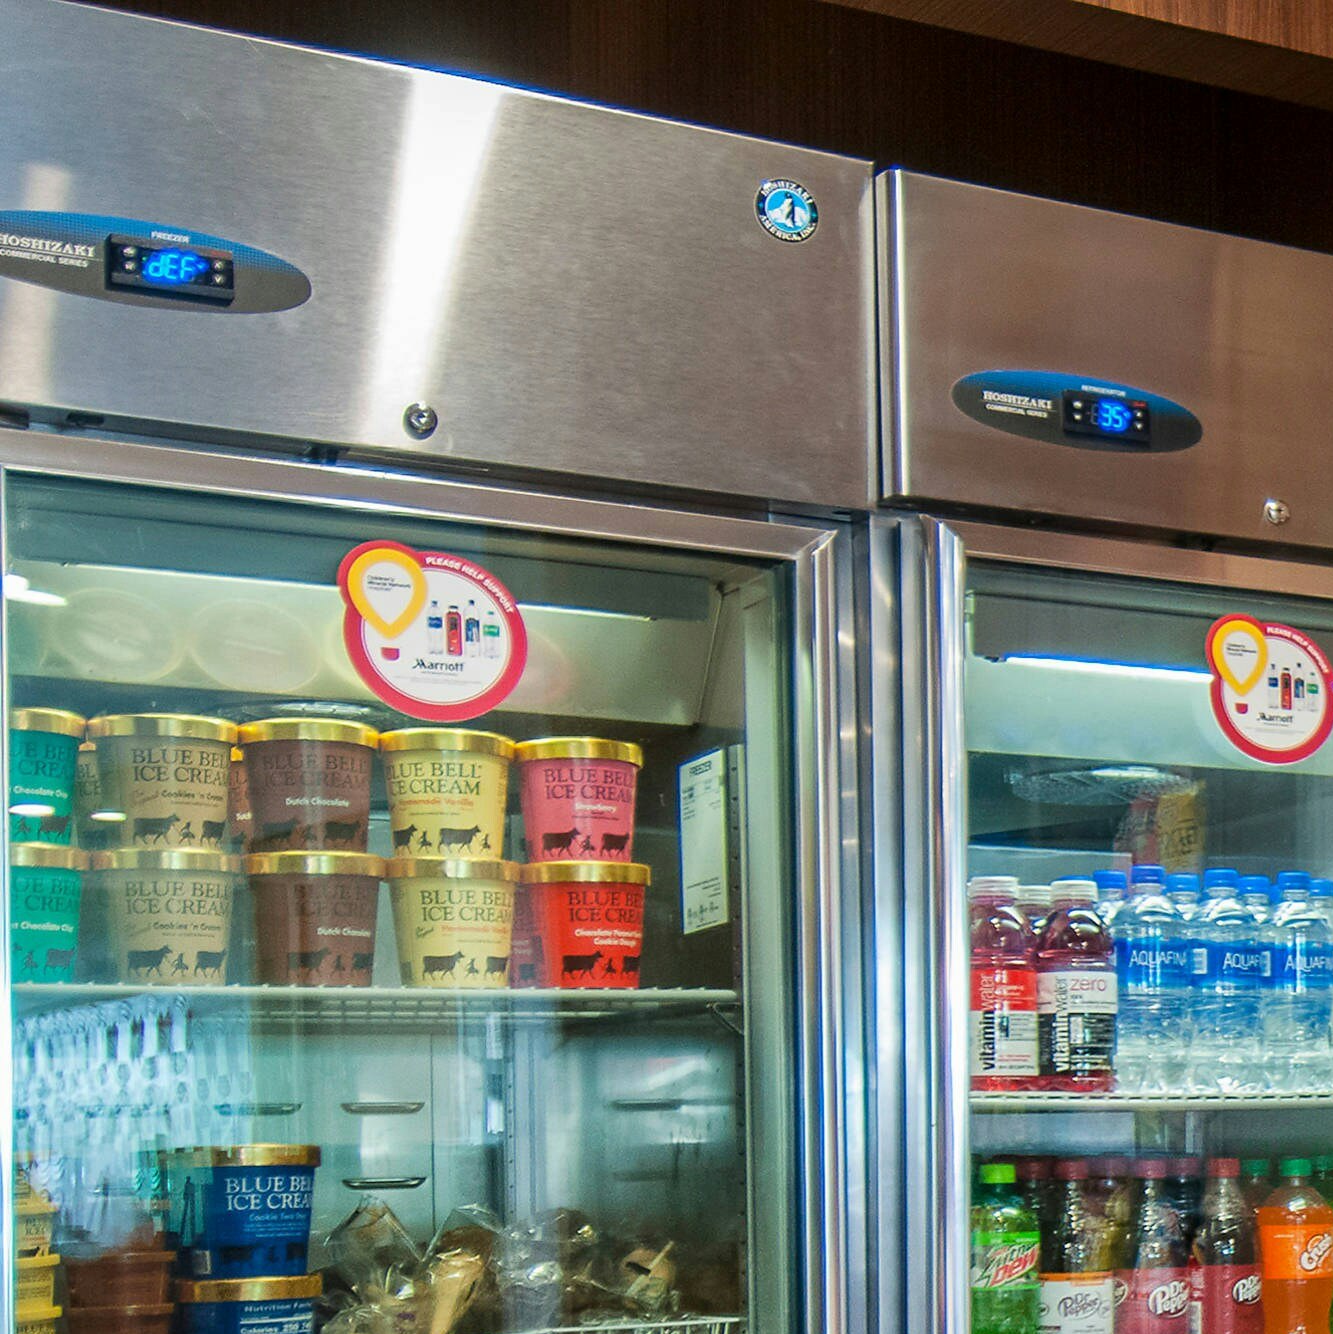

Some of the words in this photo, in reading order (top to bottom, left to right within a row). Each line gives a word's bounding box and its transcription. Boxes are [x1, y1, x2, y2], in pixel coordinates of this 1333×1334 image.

[982, 390, 1053, 410] HOSHIZAKI
[426, 556, 462, 571] PLEASE
[461, 562, 484, 582] HELP
[483, 576, 514, 614] SUPPORT
[413, 658, 465, 672] Marriott
[132, 747, 193, 765] BLUE
[133, 766, 168, 782] ICE
[432, 762, 479, 780] BELL
[544, 767, 597, 784] BLUE
[410, 779, 480, 797] CREAM
[545, 784, 572, 800] ICE
[125, 880, 184, 897] BLUE
[126, 899, 162, 914] ICE
[421, 889, 477, 907] BLUE
[567, 890, 618, 907] BLUE
[421, 906, 453, 922] ICE
[569, 907, 601, 924] ICE
[1071, 977, 1107, 992] zero
[225, 1176, 285, 1194] BLUE
[226, 1194, 260, 1211] ICE
